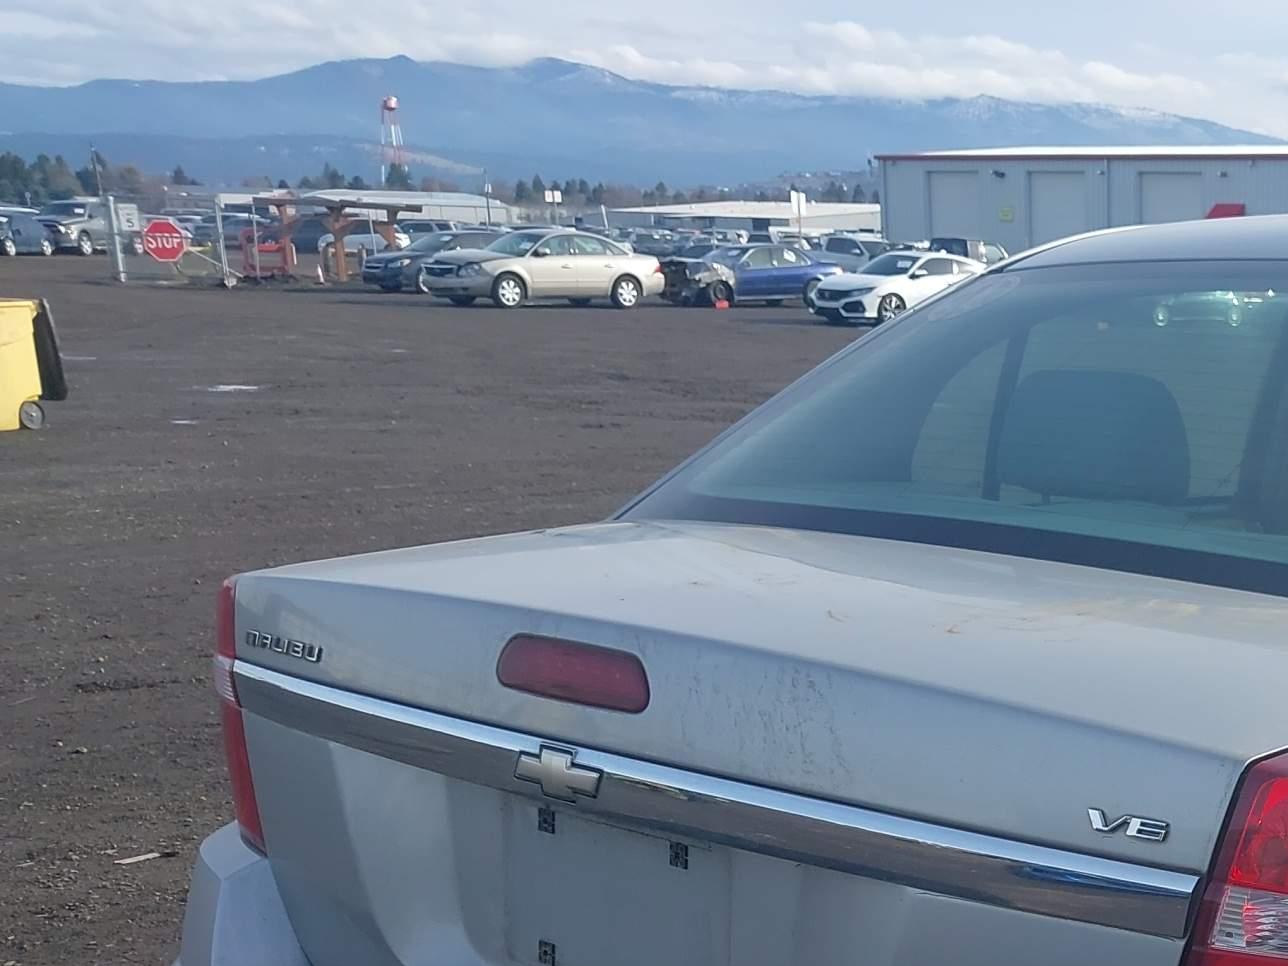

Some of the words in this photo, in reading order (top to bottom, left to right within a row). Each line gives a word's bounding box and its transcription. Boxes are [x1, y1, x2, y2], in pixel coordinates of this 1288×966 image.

[146, 233, 181, 249] STOP
[246, 628, 322, 663] MALIBU
[1087, 807, 1168, 842] V6
